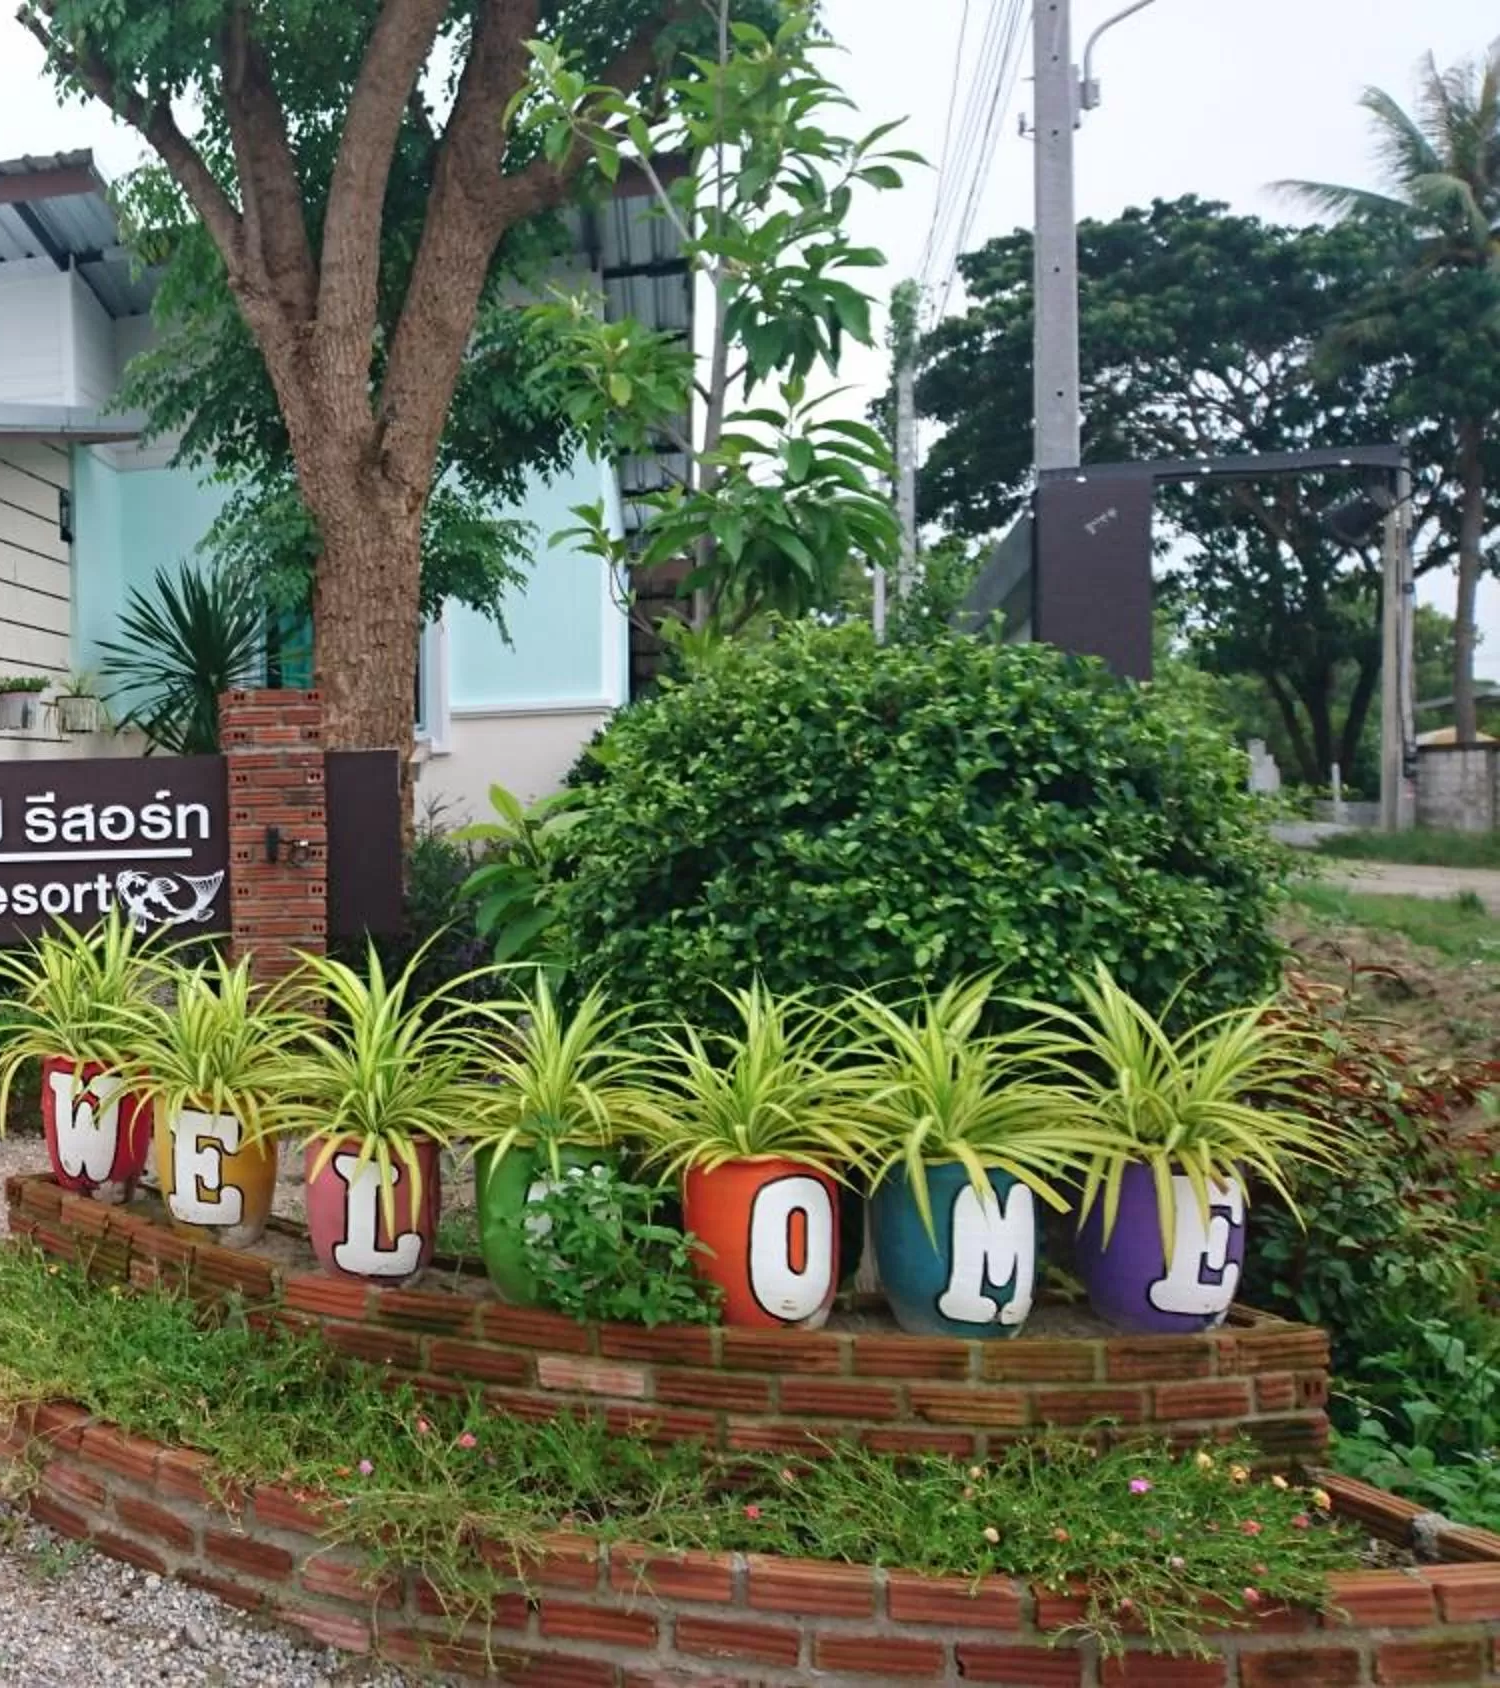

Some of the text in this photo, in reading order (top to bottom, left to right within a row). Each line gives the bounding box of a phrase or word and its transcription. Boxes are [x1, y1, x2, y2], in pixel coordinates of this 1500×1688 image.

[24, 791, 210, 843] รีสอร์ท
[49, 1071, 1243, 1326] WELOME
